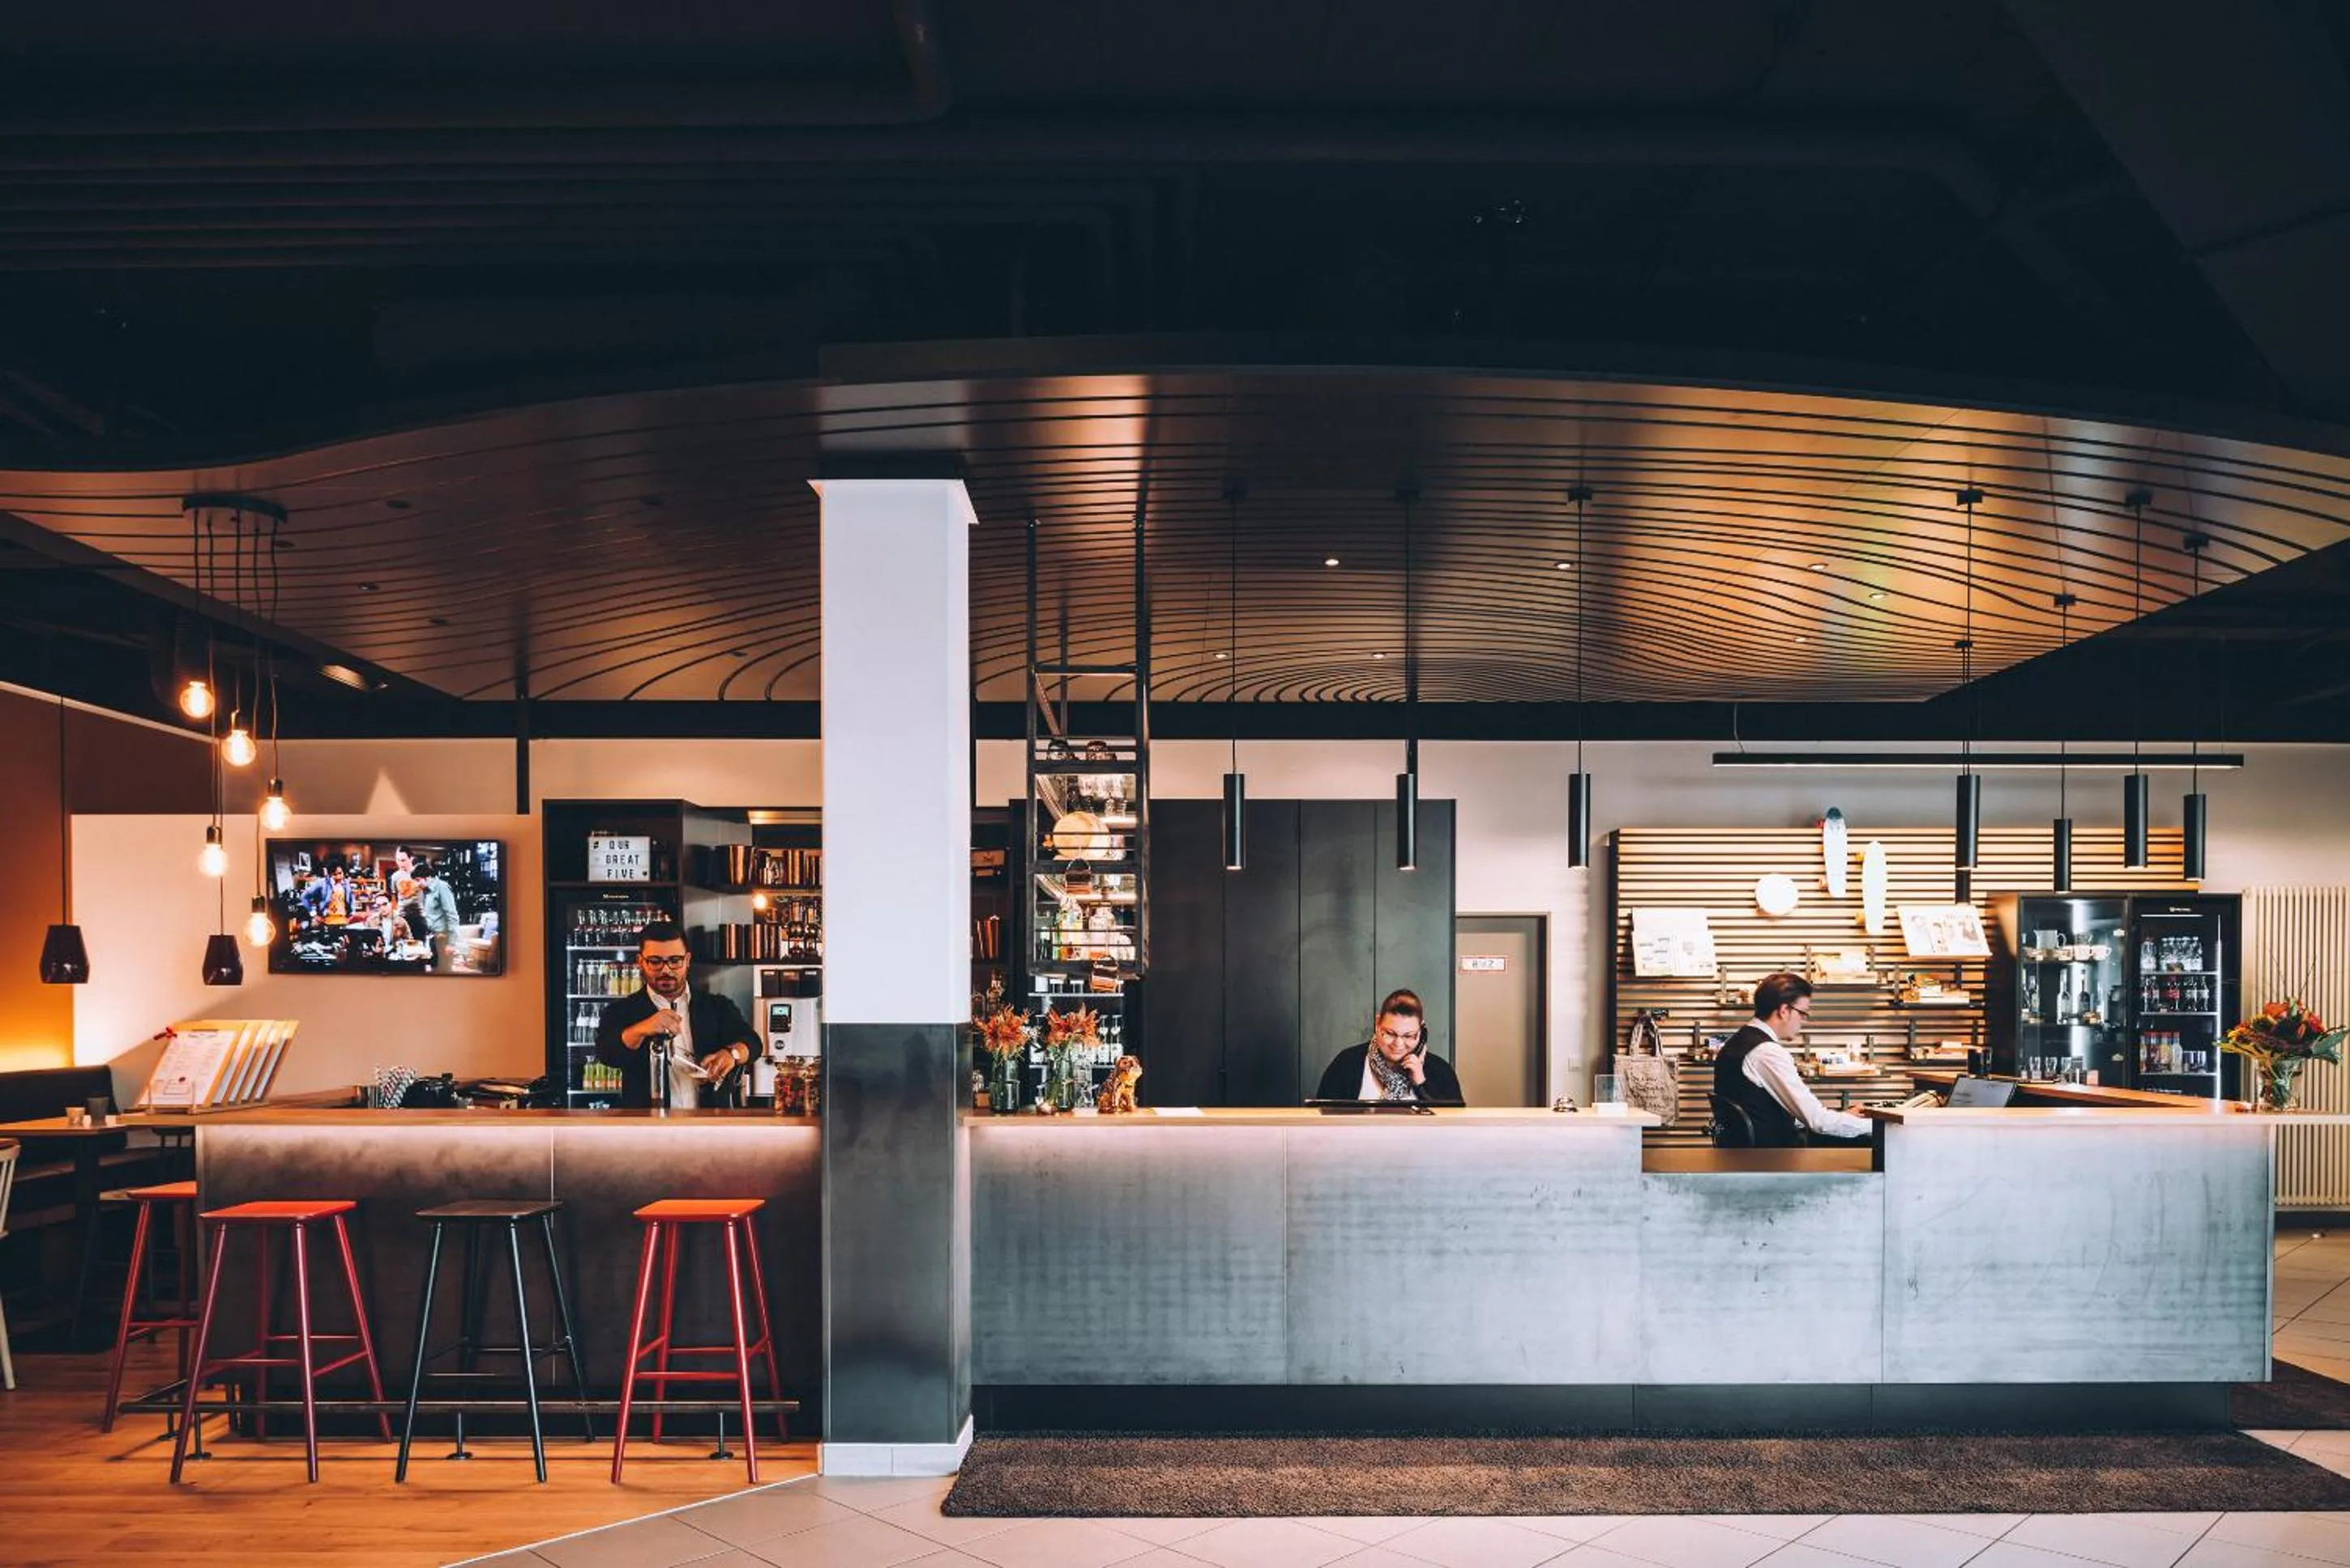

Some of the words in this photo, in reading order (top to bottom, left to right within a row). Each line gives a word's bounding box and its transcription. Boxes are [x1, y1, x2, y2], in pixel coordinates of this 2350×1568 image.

[609, 840, 630, 849] OUR
[605, 854, 640, 865] GREAT
[607, 869, 634, 879] FIVE
